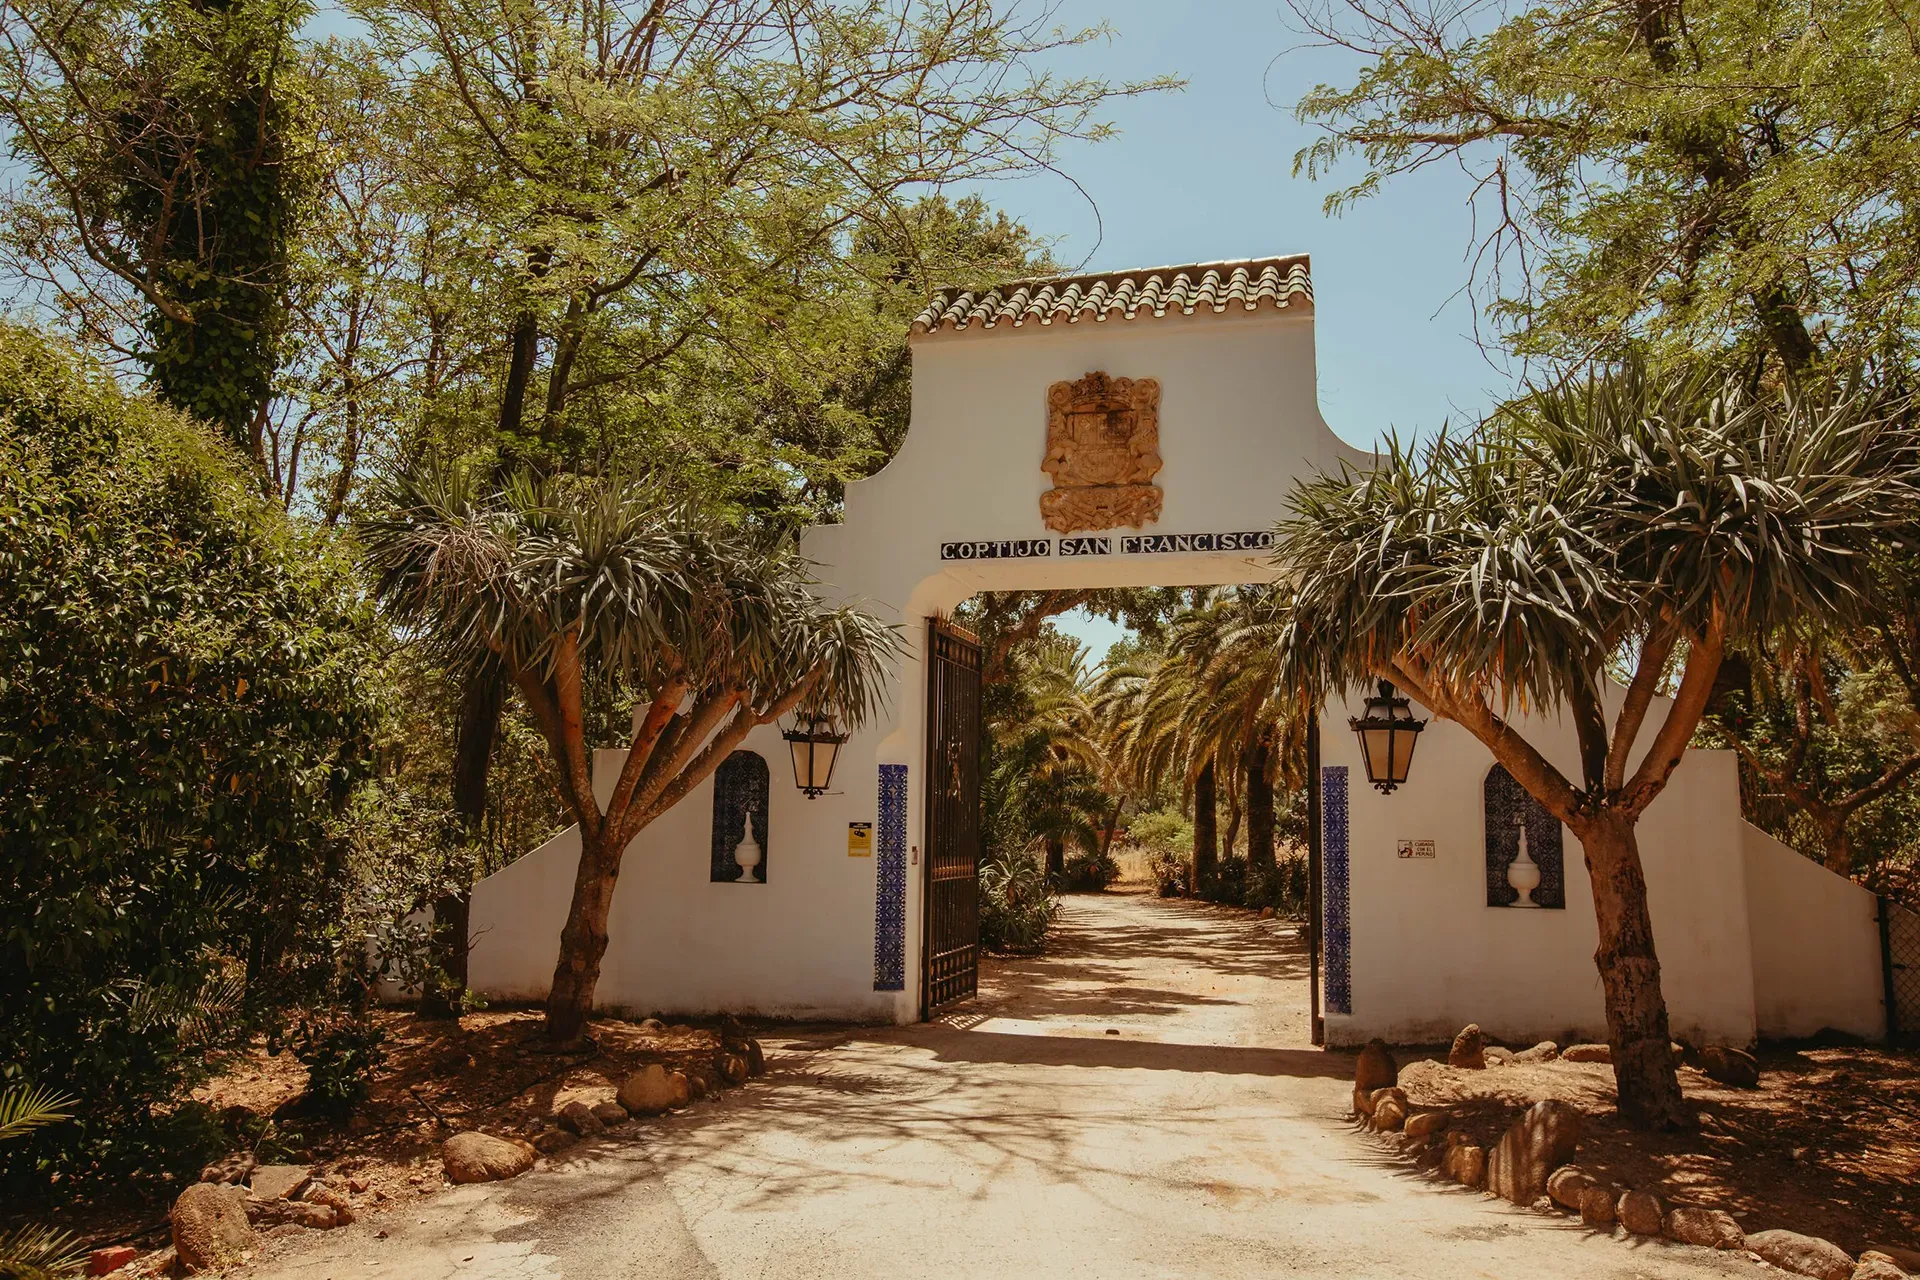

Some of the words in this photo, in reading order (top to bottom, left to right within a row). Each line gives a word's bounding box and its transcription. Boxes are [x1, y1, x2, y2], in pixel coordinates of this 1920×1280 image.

[941, 540, 1050, 559] CORTIJO
[1060, 537, 1111, 555] SAN
[1122, 532, 1274, 553] FRANCISCO
